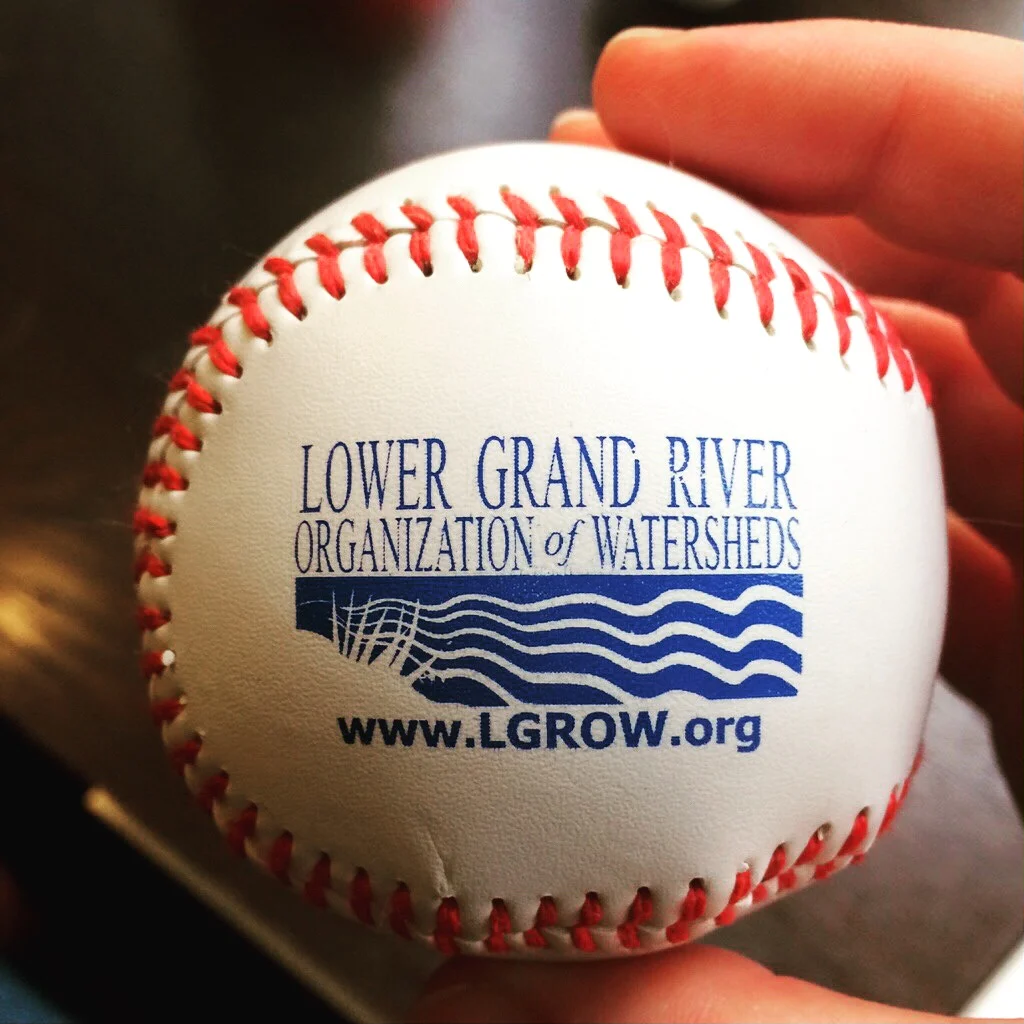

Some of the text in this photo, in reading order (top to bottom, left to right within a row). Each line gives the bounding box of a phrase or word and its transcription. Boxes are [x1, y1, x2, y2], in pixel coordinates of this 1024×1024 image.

[300, 436, 798, 514] LOWER GRAND RIVER
[294, 516, 802, 574] ORGANIZATION of WATERSHEDS
[338, 710, 762, 753] www.LGROW.org
